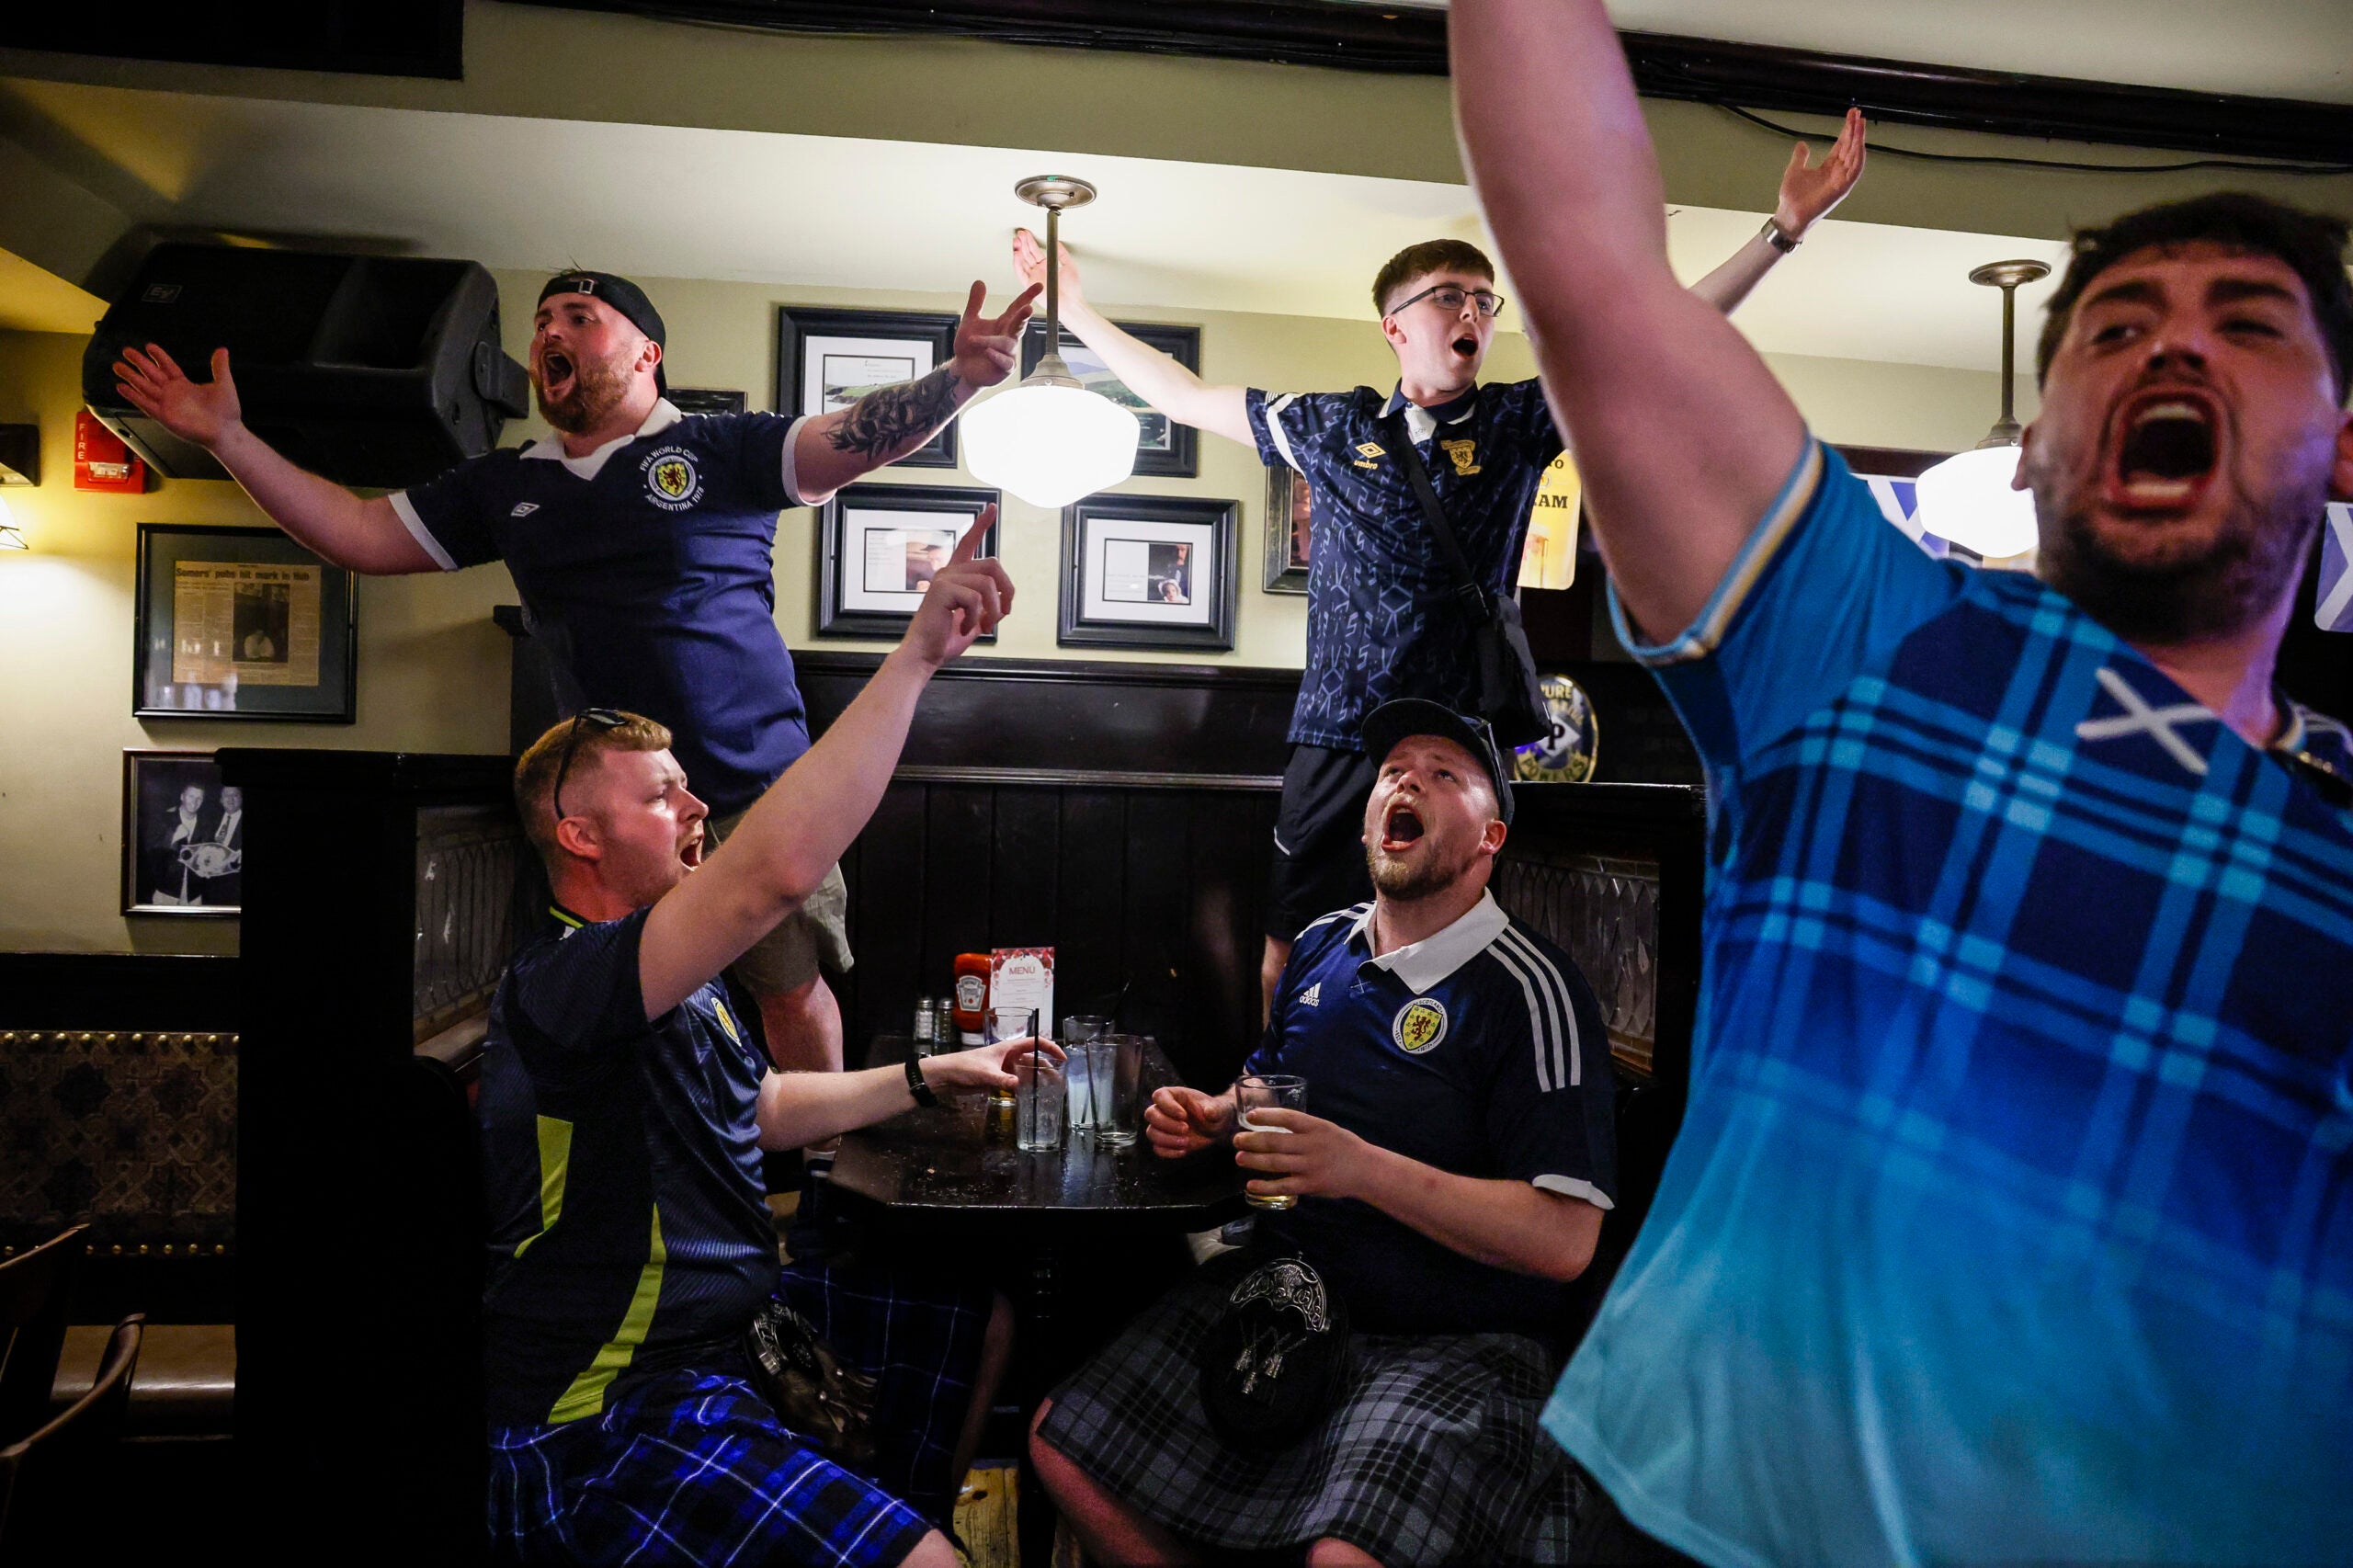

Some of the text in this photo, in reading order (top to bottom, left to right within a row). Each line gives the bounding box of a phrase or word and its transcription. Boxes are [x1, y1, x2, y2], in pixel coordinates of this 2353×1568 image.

[639, 445, 699, 472] FIFA WORLD CUP
[1353, 460, 1378, 470] umbro
[645, 485, 705, 511] ARGENTINA 1978
[1533, 494, 1568, 509] AM
[255, 571, 278, 580] mark
[281, 572, 290, 580] in
[1547, 723, 1565, 750] P
[1517, 749, 1589, 782] POWERS
[1008, 966, 1035, 975] MENU
[1299, 995, 1320, 1007] adidas
[1418, 999, 1443, 1012] SCOTLAND
